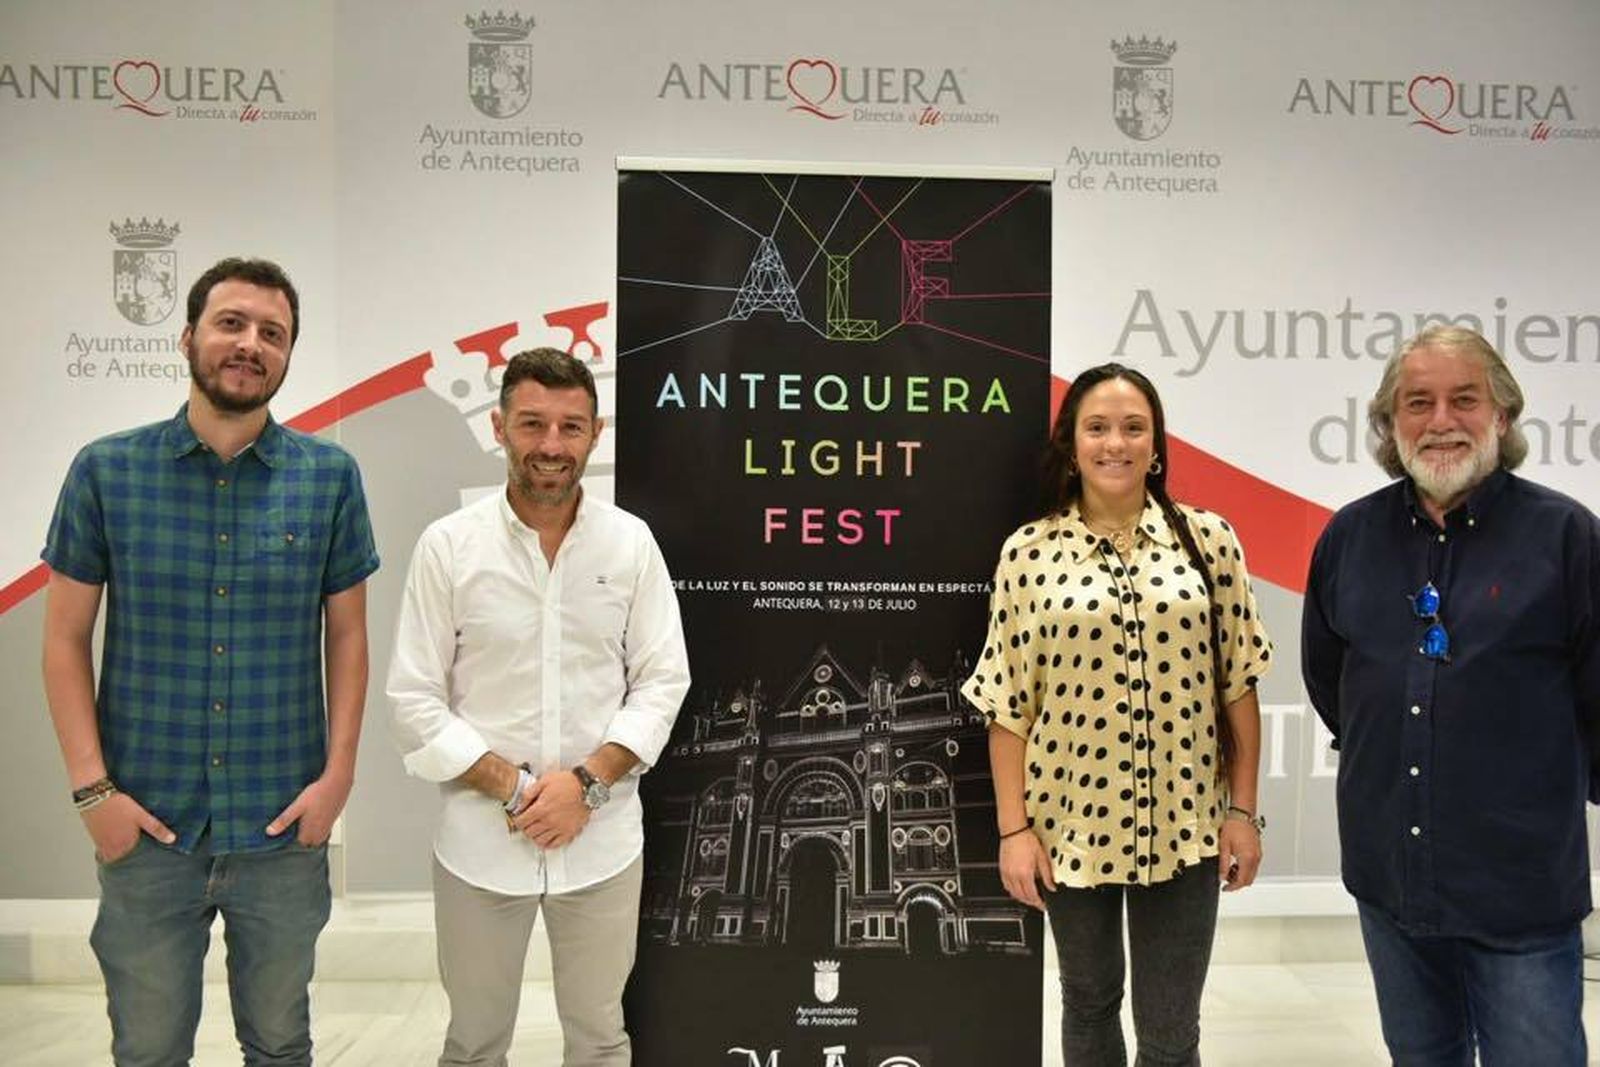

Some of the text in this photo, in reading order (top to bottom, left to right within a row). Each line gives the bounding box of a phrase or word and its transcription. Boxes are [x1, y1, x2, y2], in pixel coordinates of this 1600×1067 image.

[0, 61, 284, 117] ANTEQUERA
[658, 59, 966, 119] ANTEQUERA
[176, 104, 316, 122] Directa a tu corazón
[853, 108, 904, 122] Directa
[919, 106, 942, 125] tu
[1288, 76, 1574, 134] ANTEQUERA
[419, 124, 583, 149] Ayuntamiento
[1470, 124, 1517, 137] Directa
[1530, 122, 1552, 140] tu
[421, 150, 580, 176] de Antequera
[1066, 146, 1221, 170] Ayuntamiento
[1067, 170, 1217, 197] de Antequera
[728, 236, 952, 341] ALE
[67, 356, 96, 378] de
[656, 372, 1011, 413] ANTEQUERA
[744, 439, 921, 477] LIGHT
[764, 508, 900, 545] FEST
[688, 580, 704, 591] LA
[706, 581, 729, 591] LUZ
[732, 581, 740, 591] Y
[743, 581, 757, 591] EL
[760, 581, 805, 591] SONIDO
[808, 581, 823, 591] SE
[827, 582, 916, 592] TRANSFORMAN
[919, 583, 934, 593] EN
[753, 598, 917, 611] ANTEQUERA, 12 y 13 DE JULIO
[796, 1006, 859, 1018] Ayuntamiento
[797, 1016, 857, 1026] de Antequera
